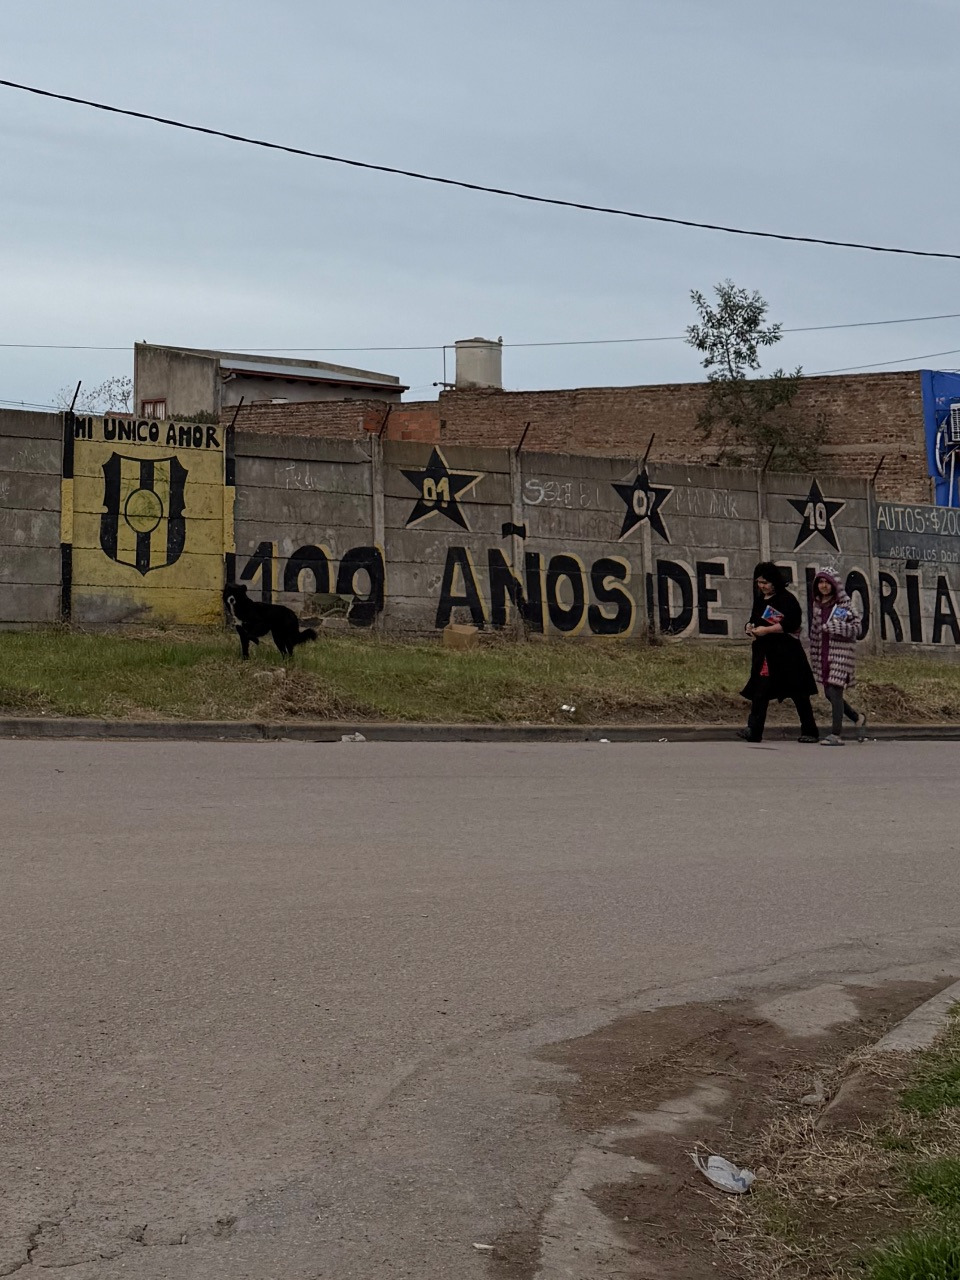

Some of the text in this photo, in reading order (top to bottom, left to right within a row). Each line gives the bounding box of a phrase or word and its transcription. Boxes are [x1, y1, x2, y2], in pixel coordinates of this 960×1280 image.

[75, 417, 220, 448] MI UNICO AMOR
[423, 476, 450, 508] 01
[632, 489, 656, 516] 07
[804, 502, 827, 530] 10
[877, 506, 929, 533] AUTOS:
[923, 549, 937, 560] LOS
[435, 522, 634, 637] AÑOS
[655, 558, 730, 637] DE
